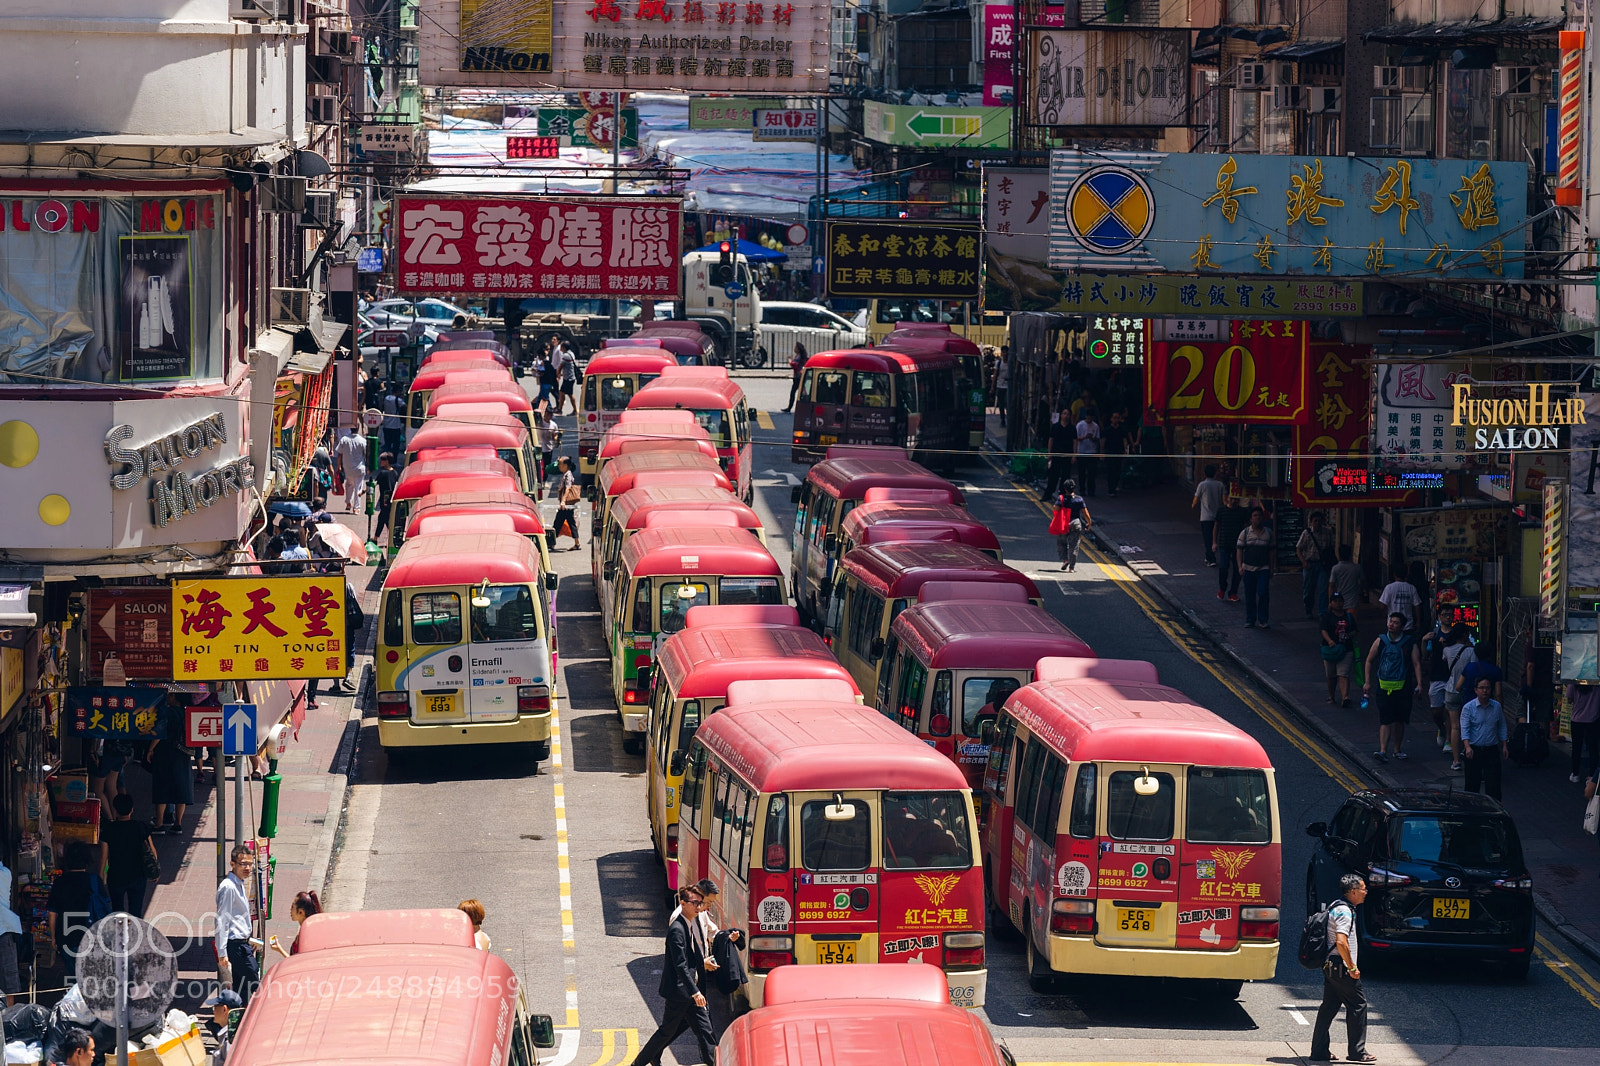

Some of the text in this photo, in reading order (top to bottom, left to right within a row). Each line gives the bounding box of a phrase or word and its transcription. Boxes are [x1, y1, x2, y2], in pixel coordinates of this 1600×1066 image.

[583, 32, 793, 53] Nikon Authorized Dealer
[462, 46, 550, 72] Nikon
[990, 50, 1012, 59] First
[0, 199, 100, 233] LON
[403, 271, 465, 288] 香濃咖啡
[471, 271, 534, 289] 香濃奶茶
[608, 272, 670, 291] 歡迎外賣
[1061, 281, 1159, 306] 特式小炒
[1178, 283, 1282, 310] 晚飯宵夜
[1292, 302, 1358, 313] 2393 1598
[1230, 319, 1295, 339] 蛋大王
[1474, 427, 1560, 450] SALON
[104, 412, 228, 491] SALON
[1335, 467, 1367, 476] Welcome
[152, 455, 256, 529] MORE
[124, 603, 167, 614] SALON
[180, 585, 340, 639] 海天堂
[184, 645, 211, 655] HOI
[233, 644, 259, 654] TIN
[283, 643, 326, 653] TONG
[183, 656, 340, 673] 鮮製龜苓膏
[471, 657, 503, 667] Ernafil
[484, 679, 495, 687] mg
[430, 704, 451, 712] 693
[820, 875, 858, 883] 紅仁汽車
[1098, 878, 1149, 887] 9699 6927
[1199, 881, 1262, 898] 紅仁汽車
[1444, 898, 1459, 908] UA
[799, 910, 851, 919] 9699 6927
[904, 908, 968, 925] 紅仁汽車
[1127, 910, 1145, 920] EG
[1436, 908, 1467, 918] 8277
[1121, 921, 1150, 931] 548
[827, 943, 845, 953] LV
[819, 953, 855, 964] 1594
